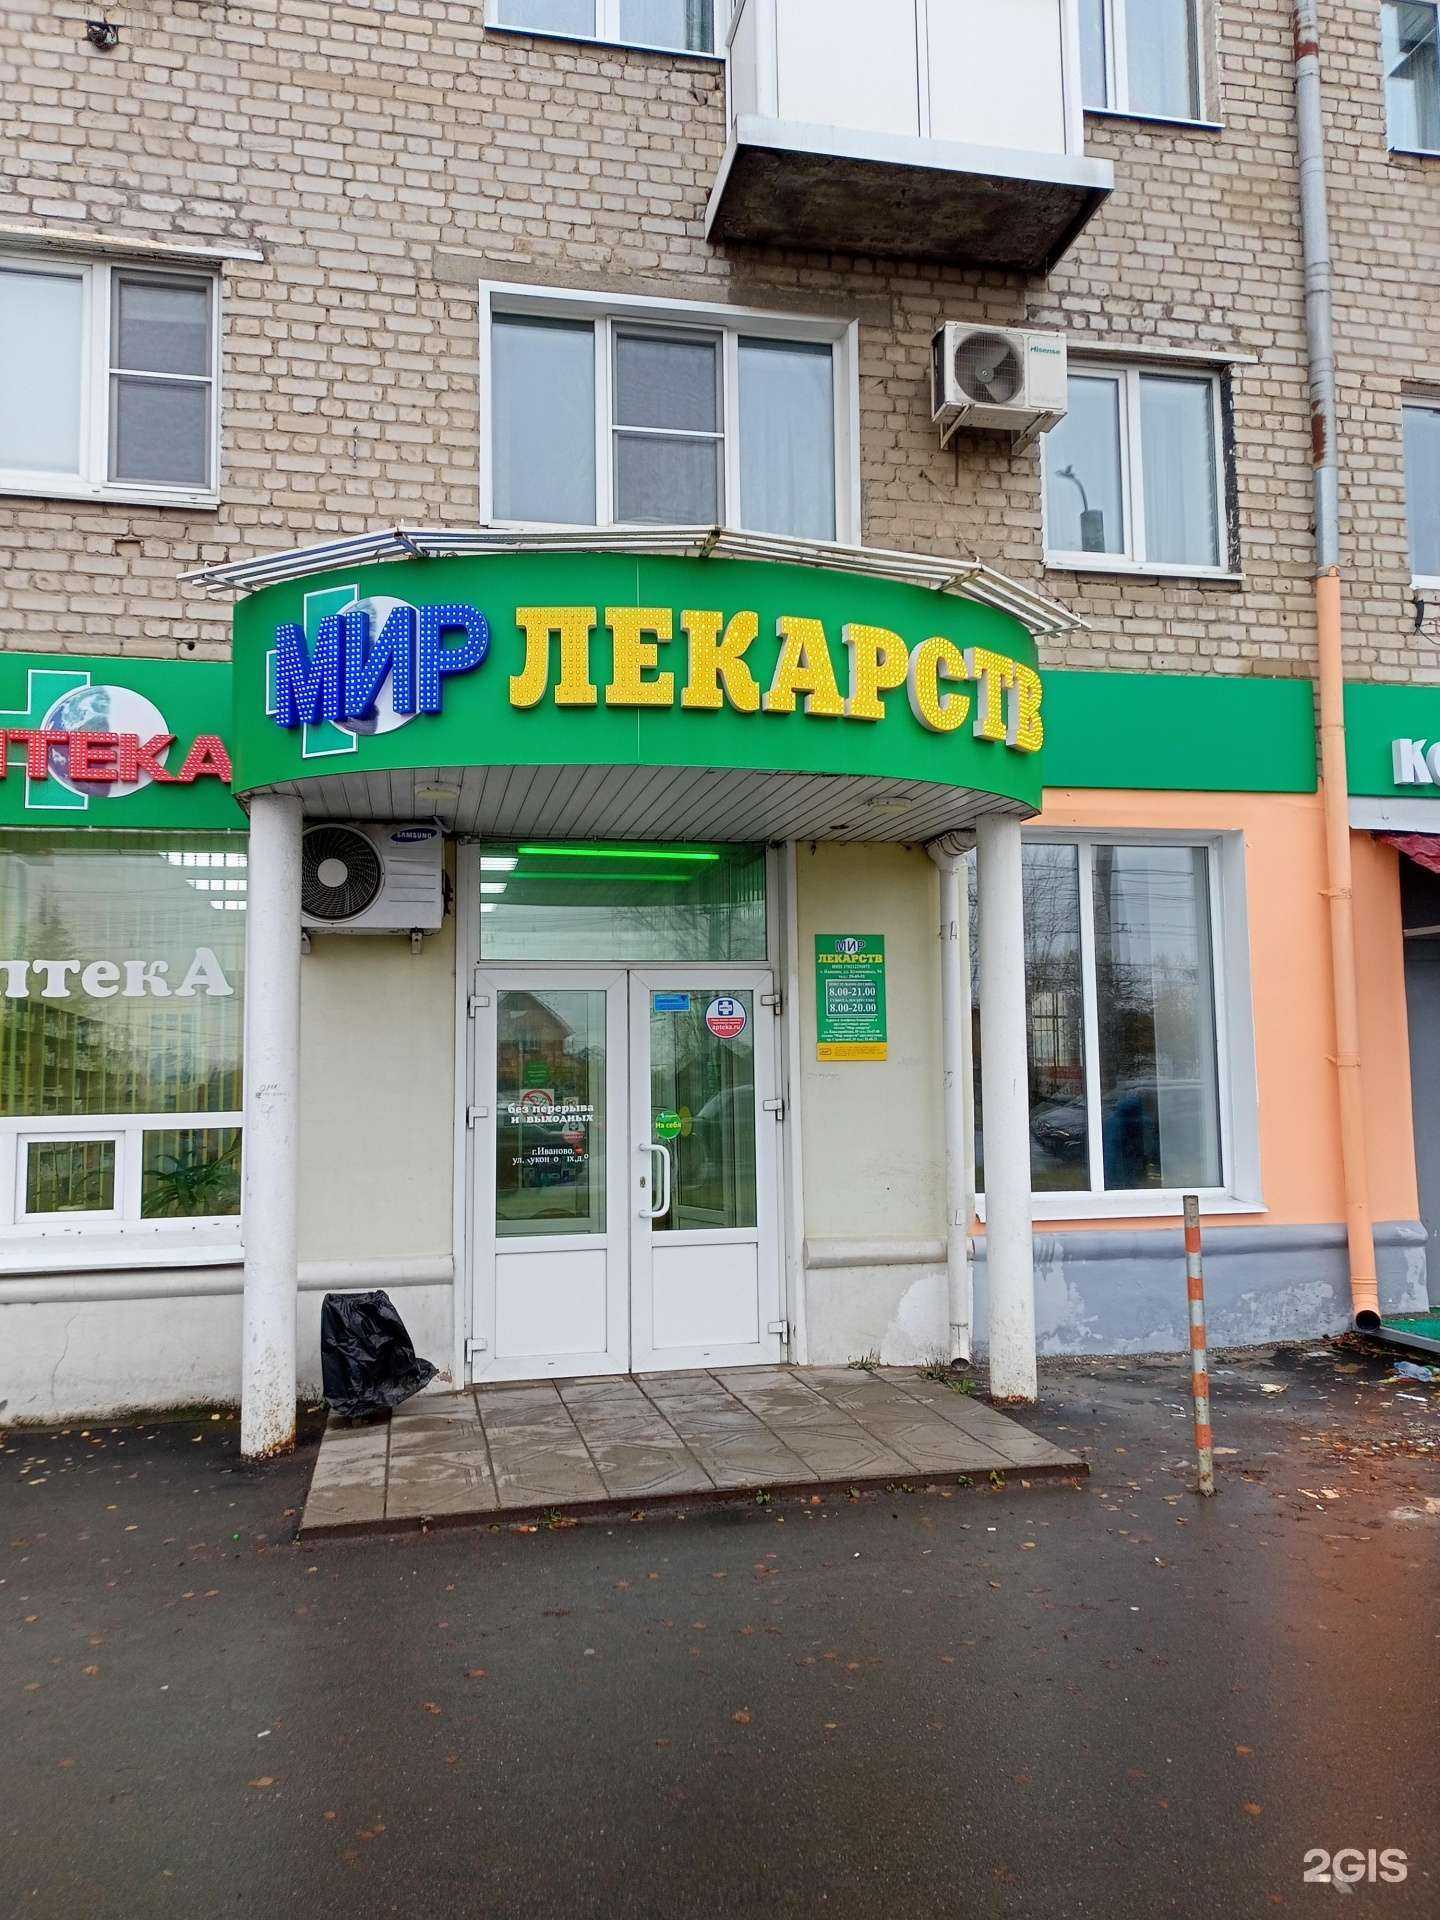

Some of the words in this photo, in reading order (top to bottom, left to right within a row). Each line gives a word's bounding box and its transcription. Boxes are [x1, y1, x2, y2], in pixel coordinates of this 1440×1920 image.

[275, 603, 489, 730] МИР
[509, 606, 1044, 753] ЛЕКАРСТВ
[0, 729, 232, 784] ТЕКА
[396, 831, 432, 840] SAMSUNG
[836, 940, 865, 952] МИР
[818, 954, 883, 963] ЛЕКАРСТВ
[829, 987, 876, 997] 8.00-21.00
[829, 1003, 877, 1012] 8.00-20.00
[508, 1102, 528, 1114] без
[532, 1104, 594, 1115] перерыва
[511, 1116, 520, 1124] и
[527, 1114, 594, 1124] выходных
